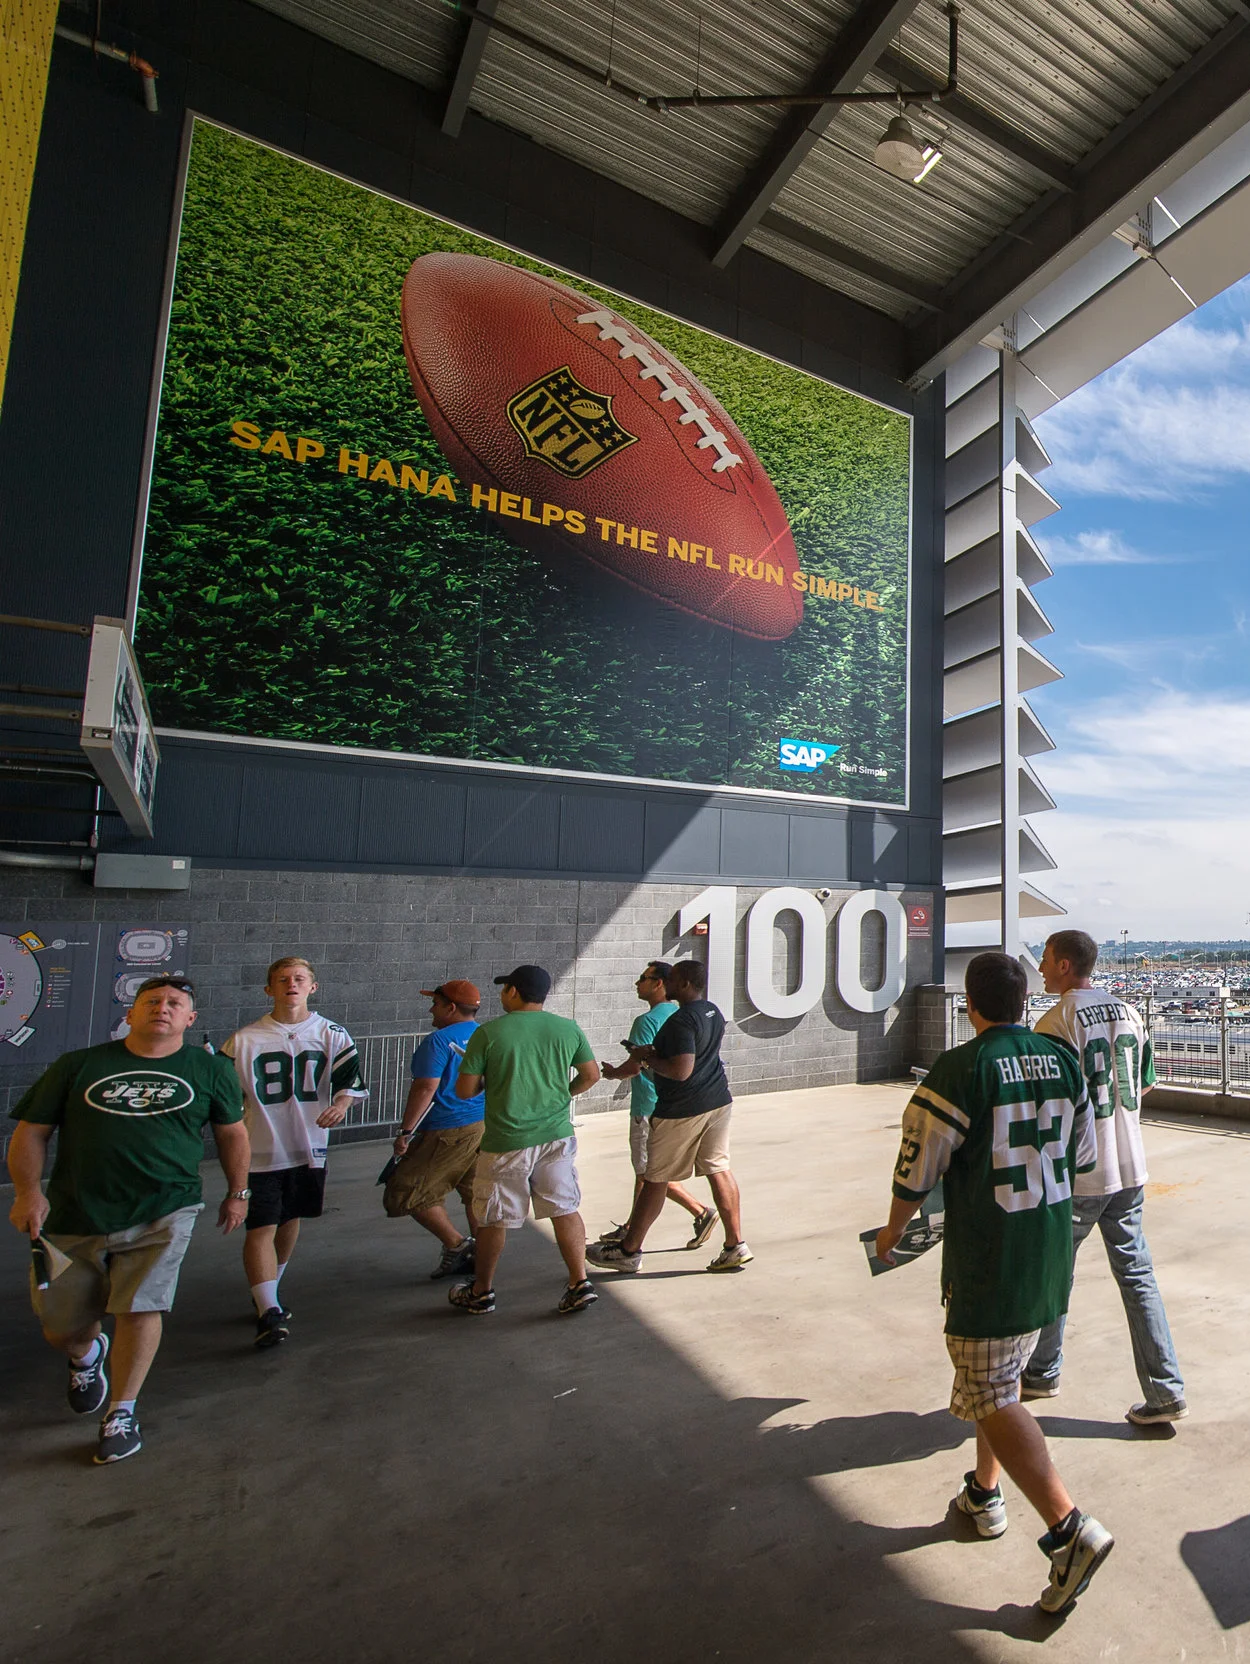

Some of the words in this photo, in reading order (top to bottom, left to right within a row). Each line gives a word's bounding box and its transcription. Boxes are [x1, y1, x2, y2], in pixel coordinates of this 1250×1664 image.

[515, 389, 594, 466] NFL
[229, 420, 326, 463] SAP
[338, 448, 457, 502] HANA
[471, 483, 586, 534] HELPS
[595, 517, 658, 554] THE
[667, 537, 722, 570] NFL
[729, 553, 784, 586] RUN
[791, 571, 885, 612] SIMPLE.
[780, 743, 827, 768] SAP
[840, 763, 858, 773] Run
[858, 765, 888, 777] Simple
[679, 885, 908, 1022] 100
[1076, 1003, 1131, 1029] CHREBET
[102, 1084, 176, 1098] JETS
[252, 1050, 329, 1105] 80
[1083, 1033, 1139, 1119] 80
[992, 1098, 1076, 1213] 52
